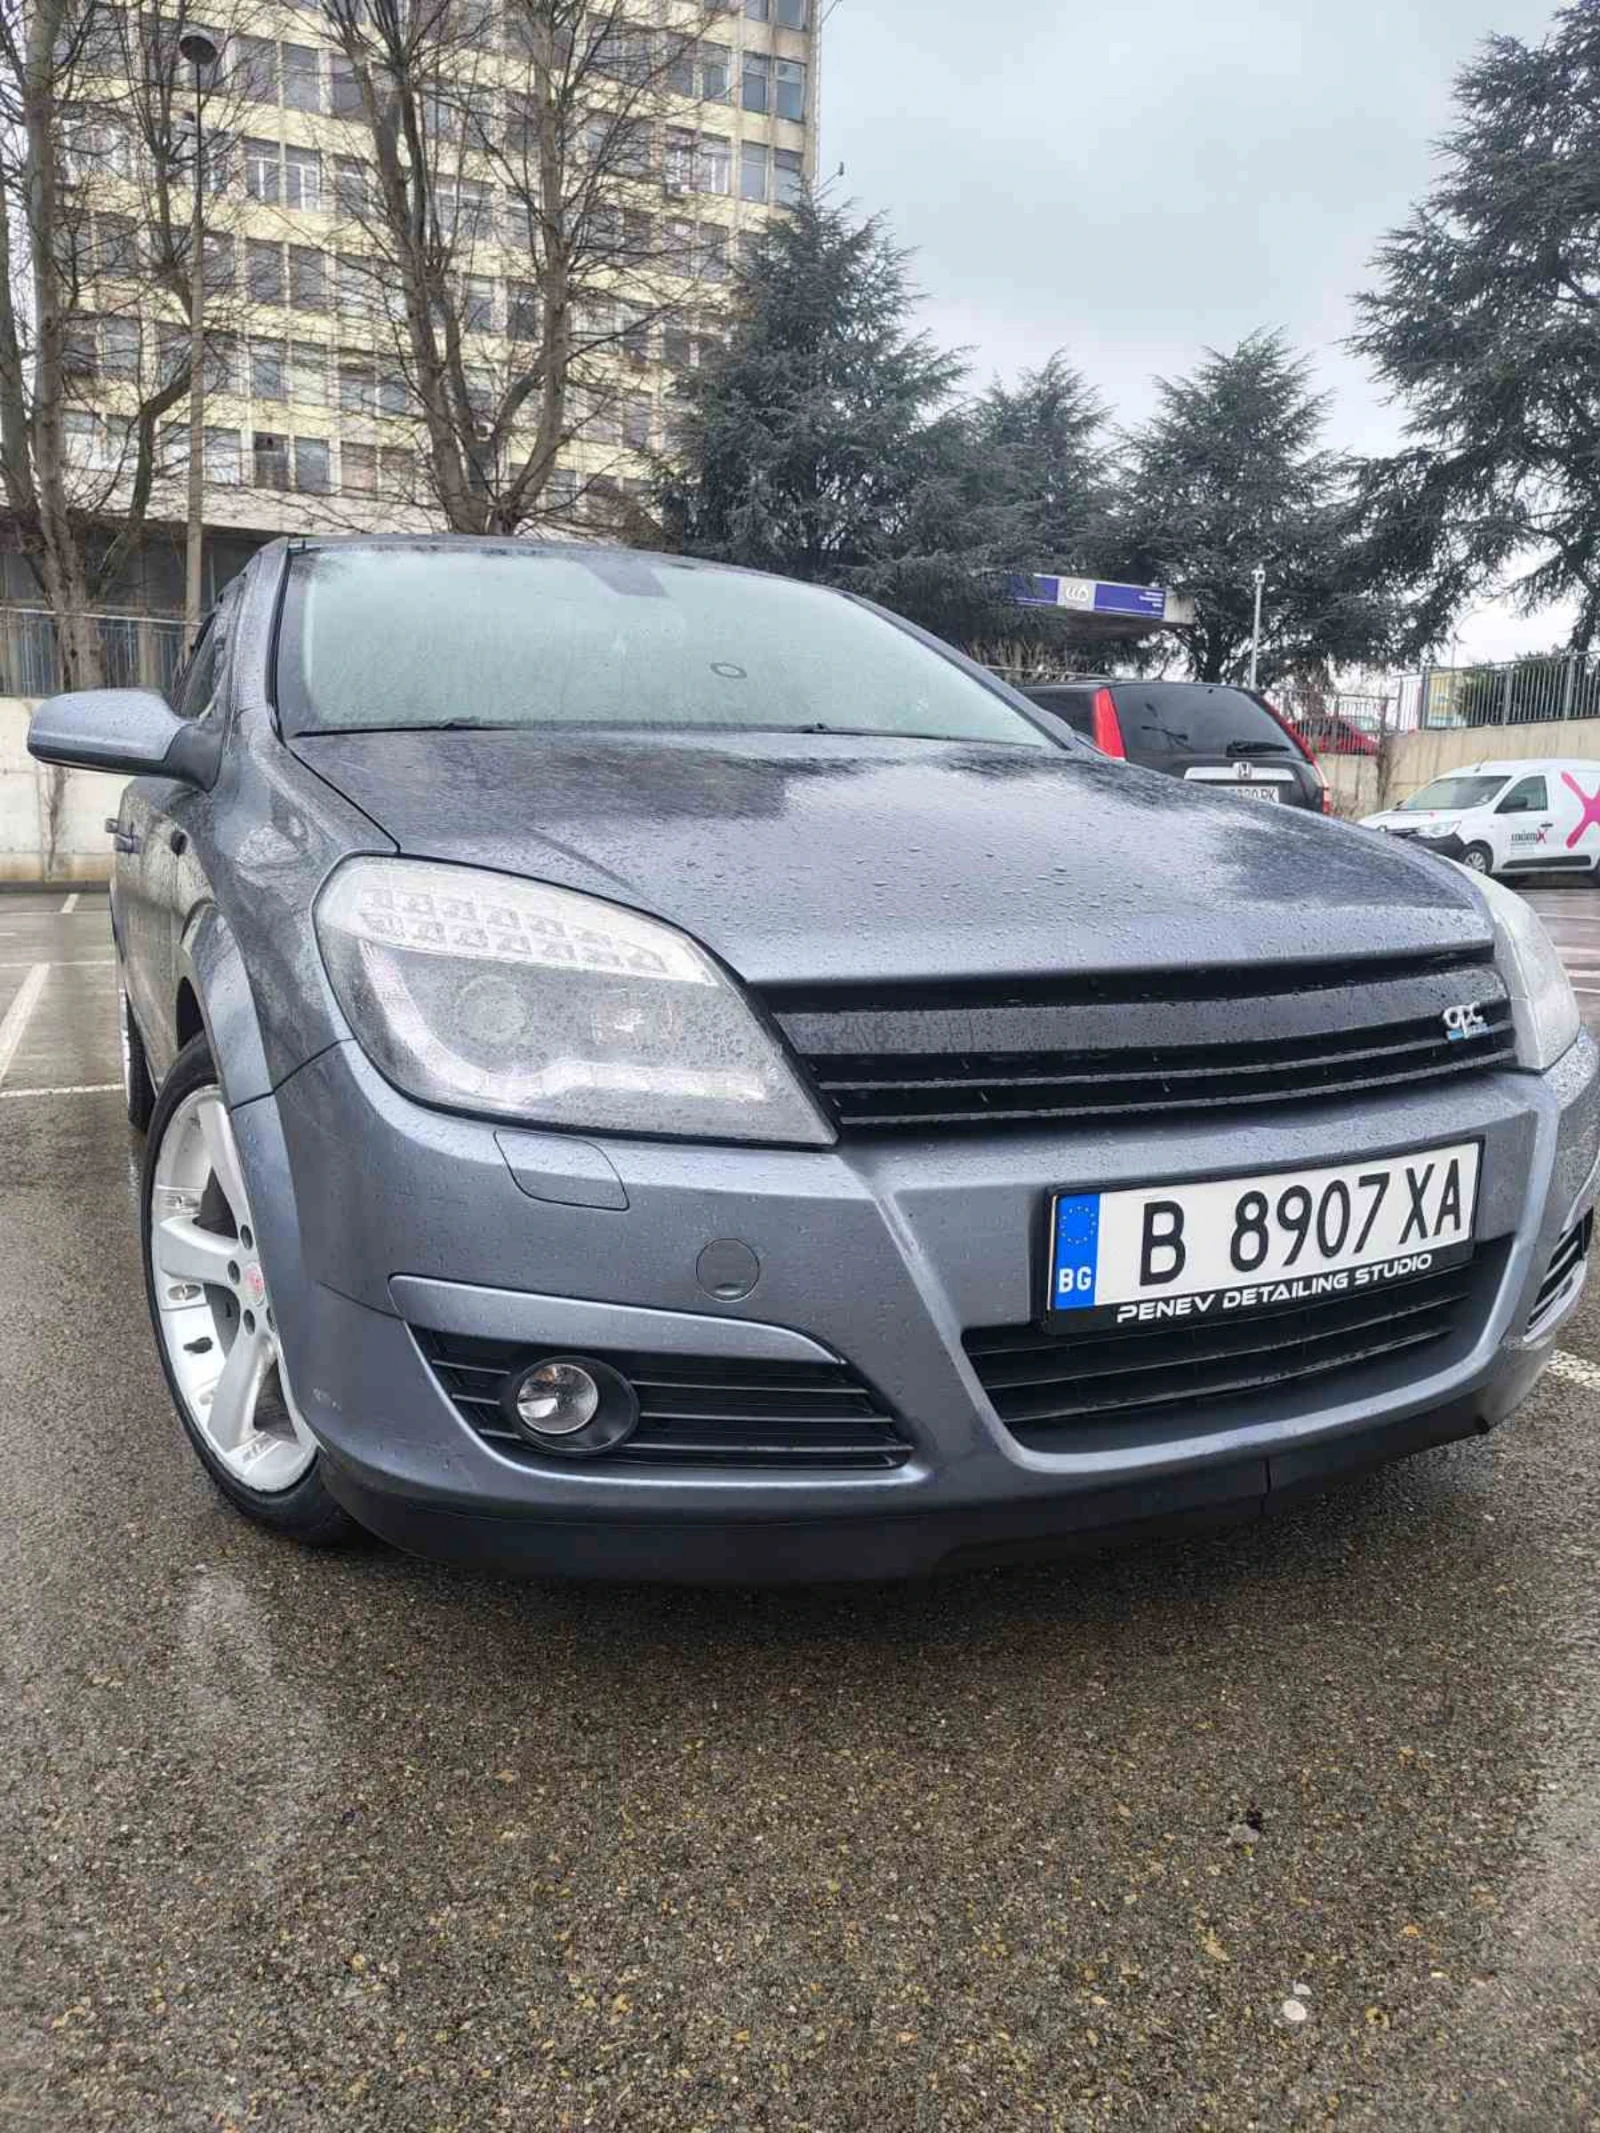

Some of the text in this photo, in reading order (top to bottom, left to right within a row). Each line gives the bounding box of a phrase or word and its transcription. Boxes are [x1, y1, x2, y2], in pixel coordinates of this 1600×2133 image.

[1139, 1158, 1461, 1287] B 8907 XA
[1058, 1265, 1092, 1293] BG
[1117, 1253, 1433, 1323] PENEV DETAILING STUDIO
